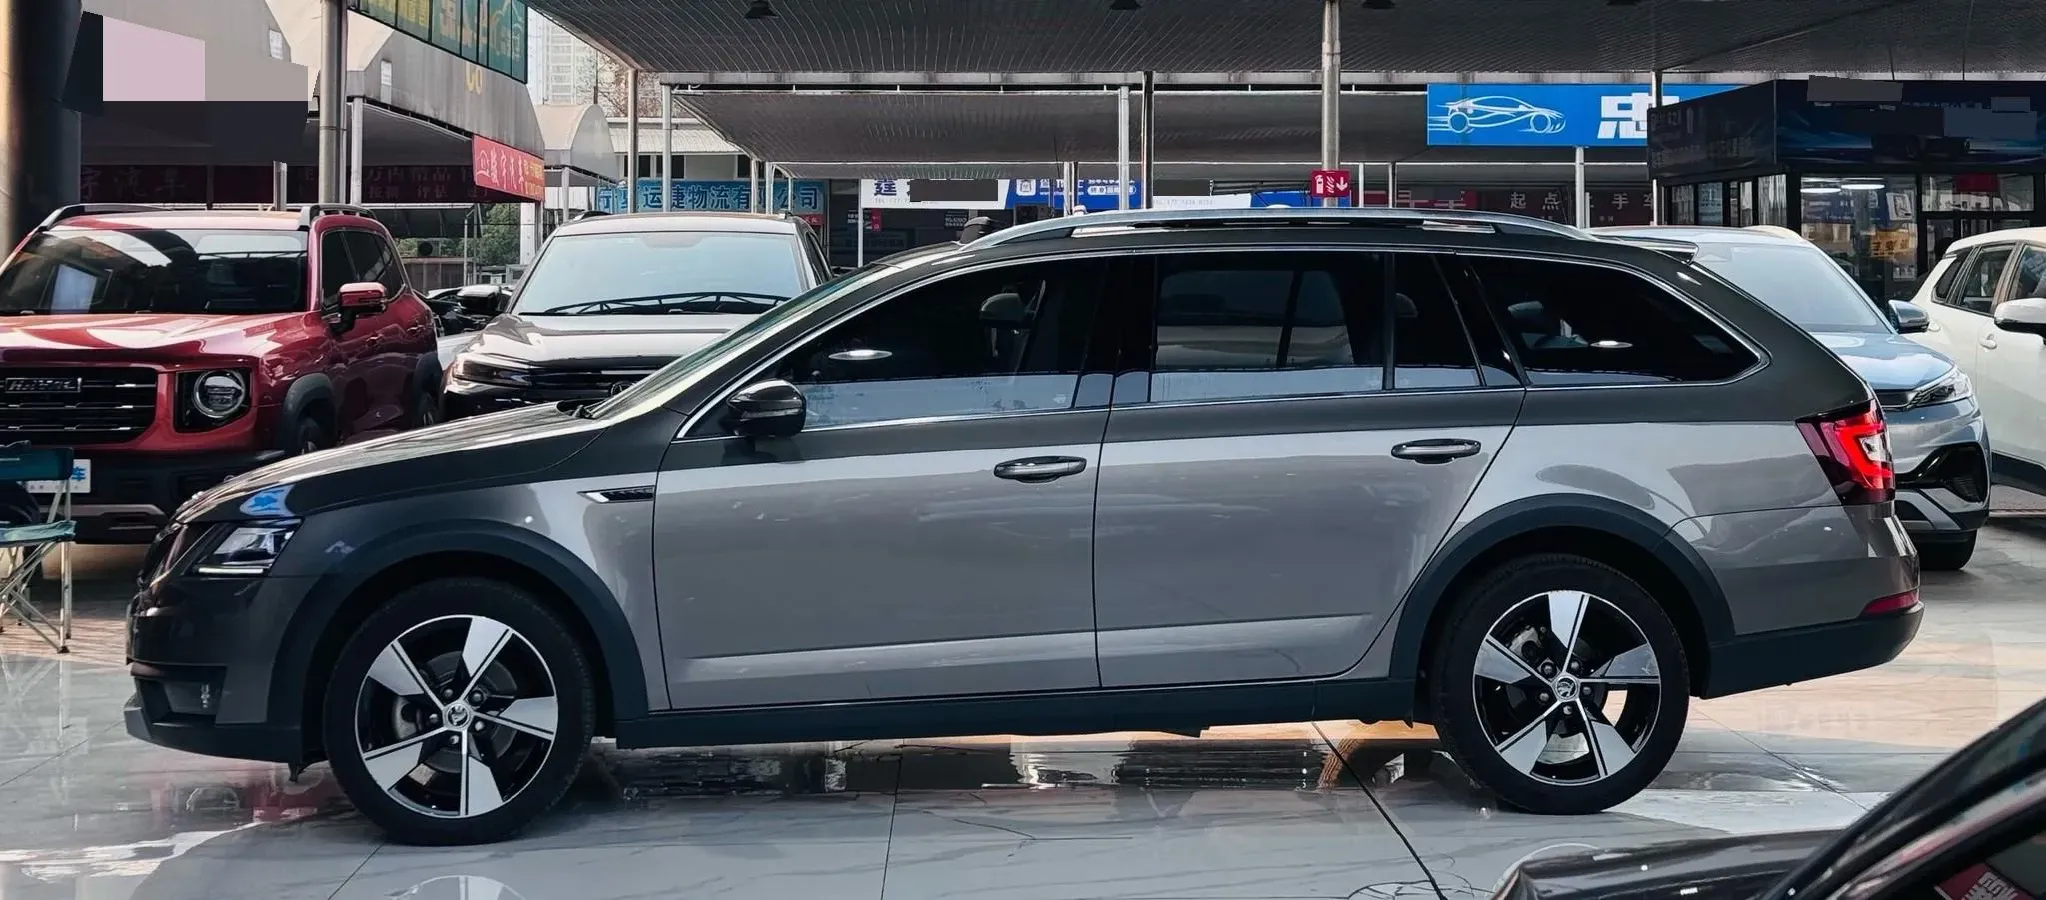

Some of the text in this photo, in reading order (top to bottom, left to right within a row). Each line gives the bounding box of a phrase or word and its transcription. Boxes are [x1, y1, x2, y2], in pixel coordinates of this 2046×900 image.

[598, 184, 818, 209] 宁运捷物流有公司
[1510, 191, 1653, 211] 起点手车
